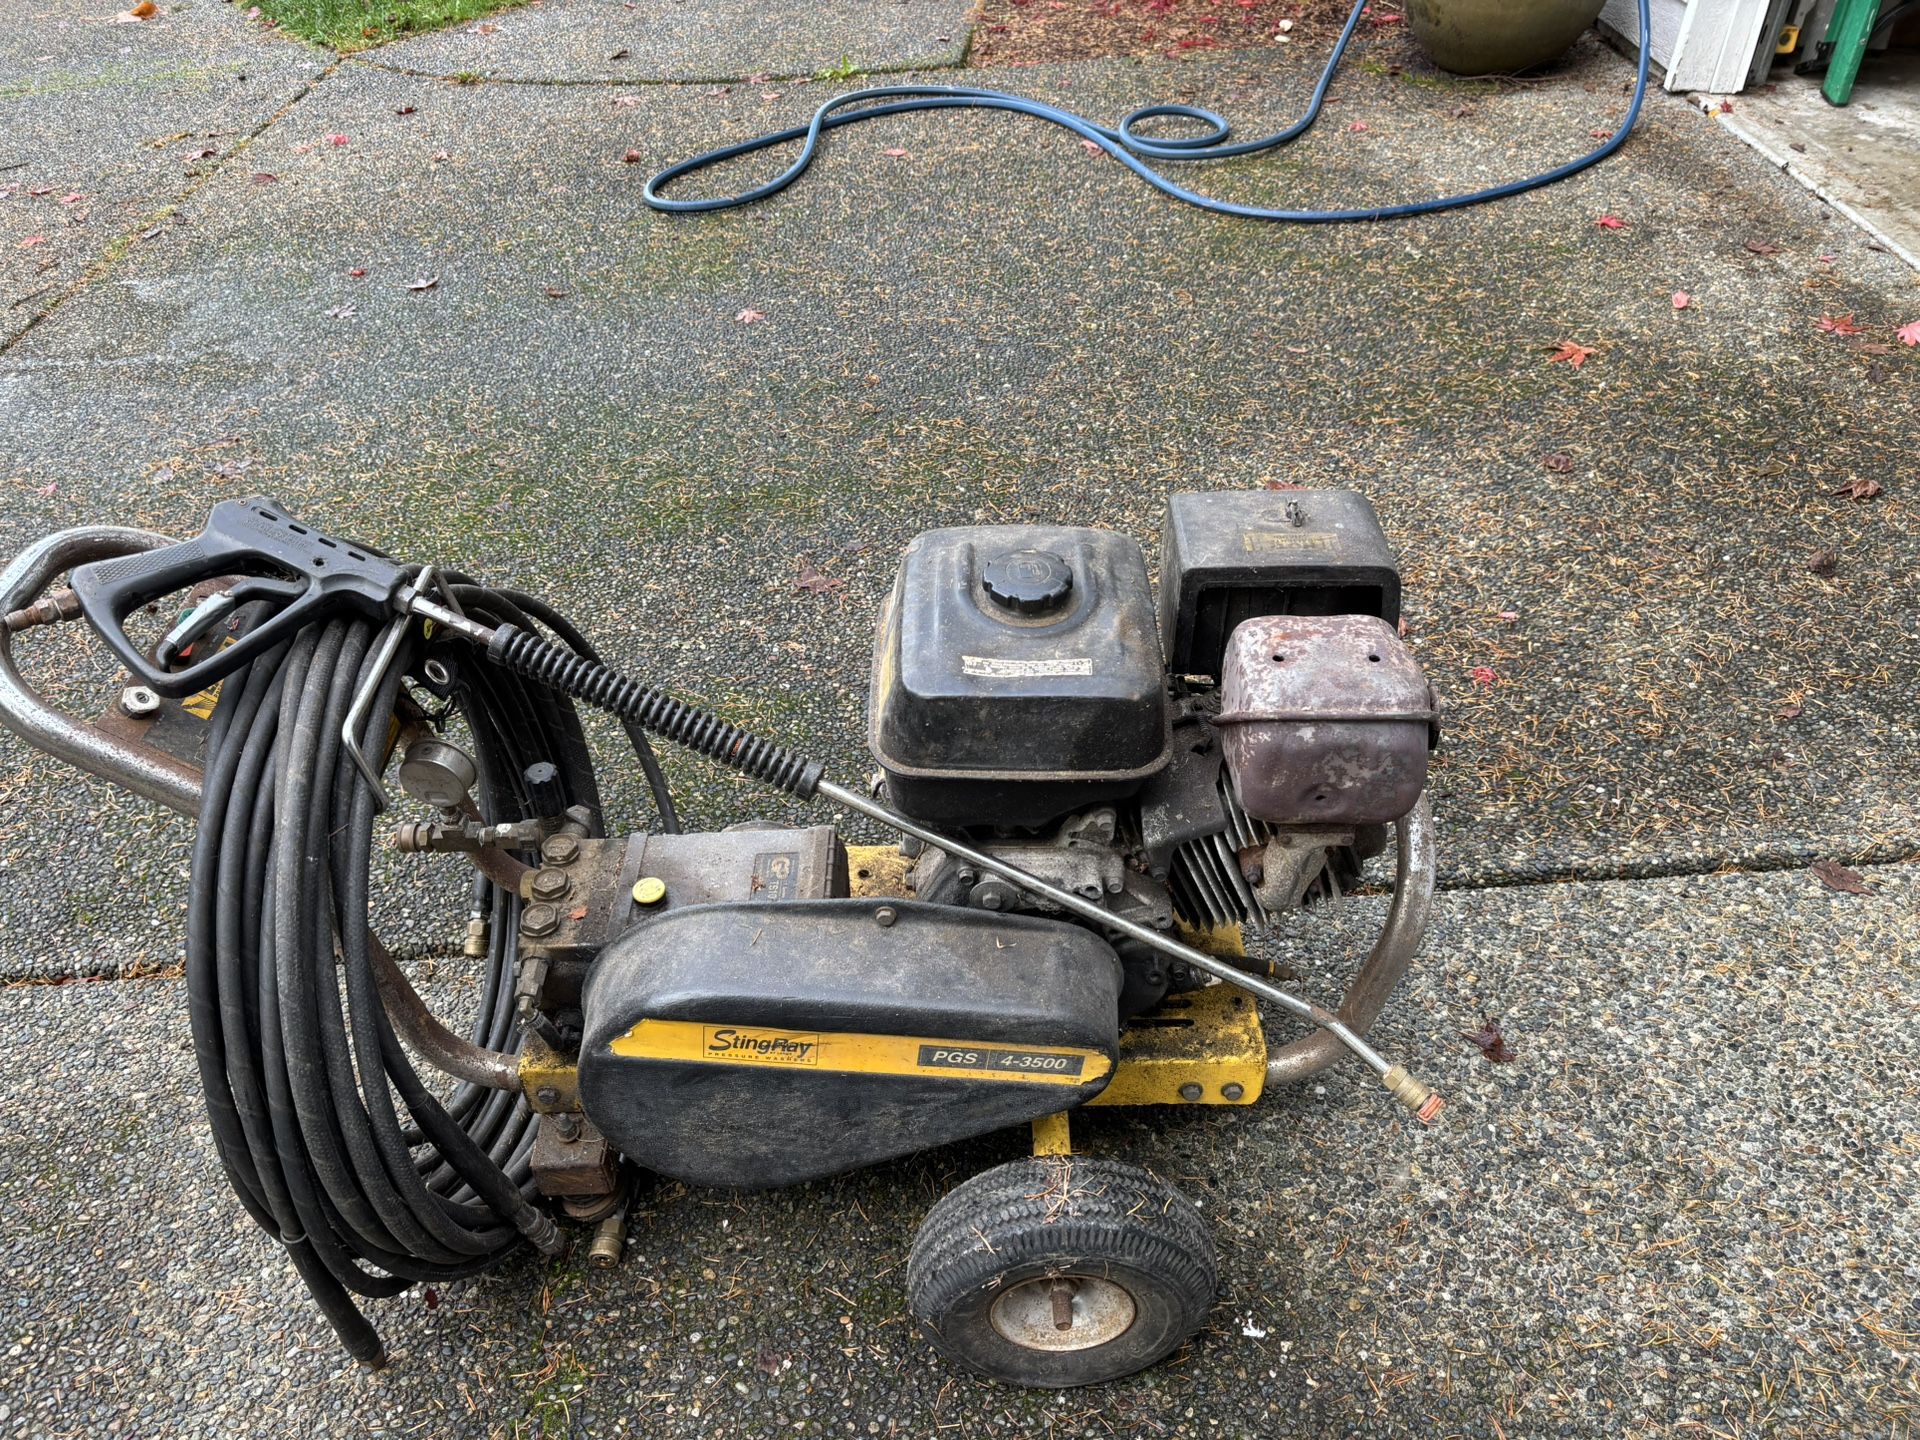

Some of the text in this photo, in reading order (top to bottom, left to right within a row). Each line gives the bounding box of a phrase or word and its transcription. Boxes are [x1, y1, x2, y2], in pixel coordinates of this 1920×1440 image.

[708, 1029, 813, 1058] StingRay
[932, 1051, 1067, 1069] PGS 4-3500
